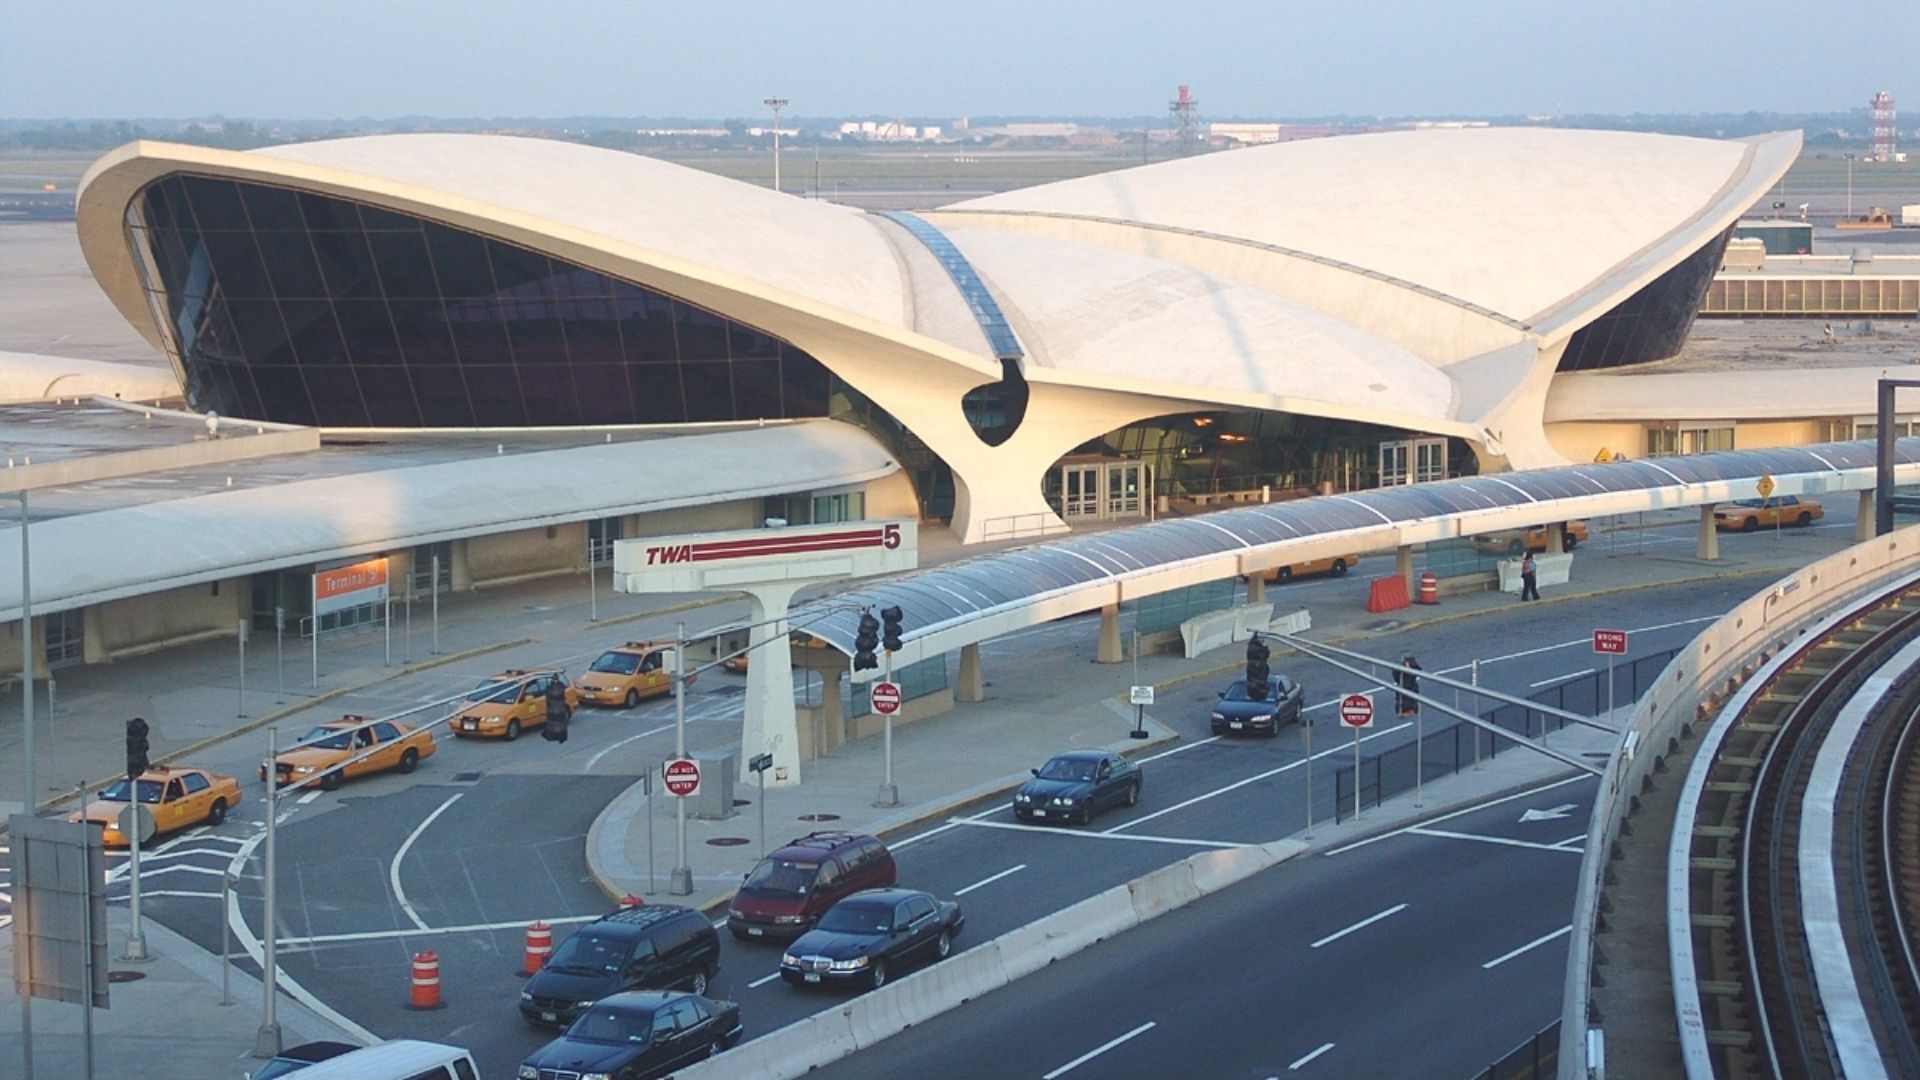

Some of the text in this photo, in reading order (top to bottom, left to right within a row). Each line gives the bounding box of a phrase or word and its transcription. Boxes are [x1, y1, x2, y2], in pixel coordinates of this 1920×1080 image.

[884, 524, 901, 550] 5
[646, 544, 692, 565] TWA
[326, 570, 366, 592] Terminal
[1597, 633, 1623, 642] WRONG
[1602, 642, 1617, 650] WAY
[877, 701, 895, 709] ENTER
[681, 766, 694, 774] NOT
[672, 782, 692, 790] ENTER
